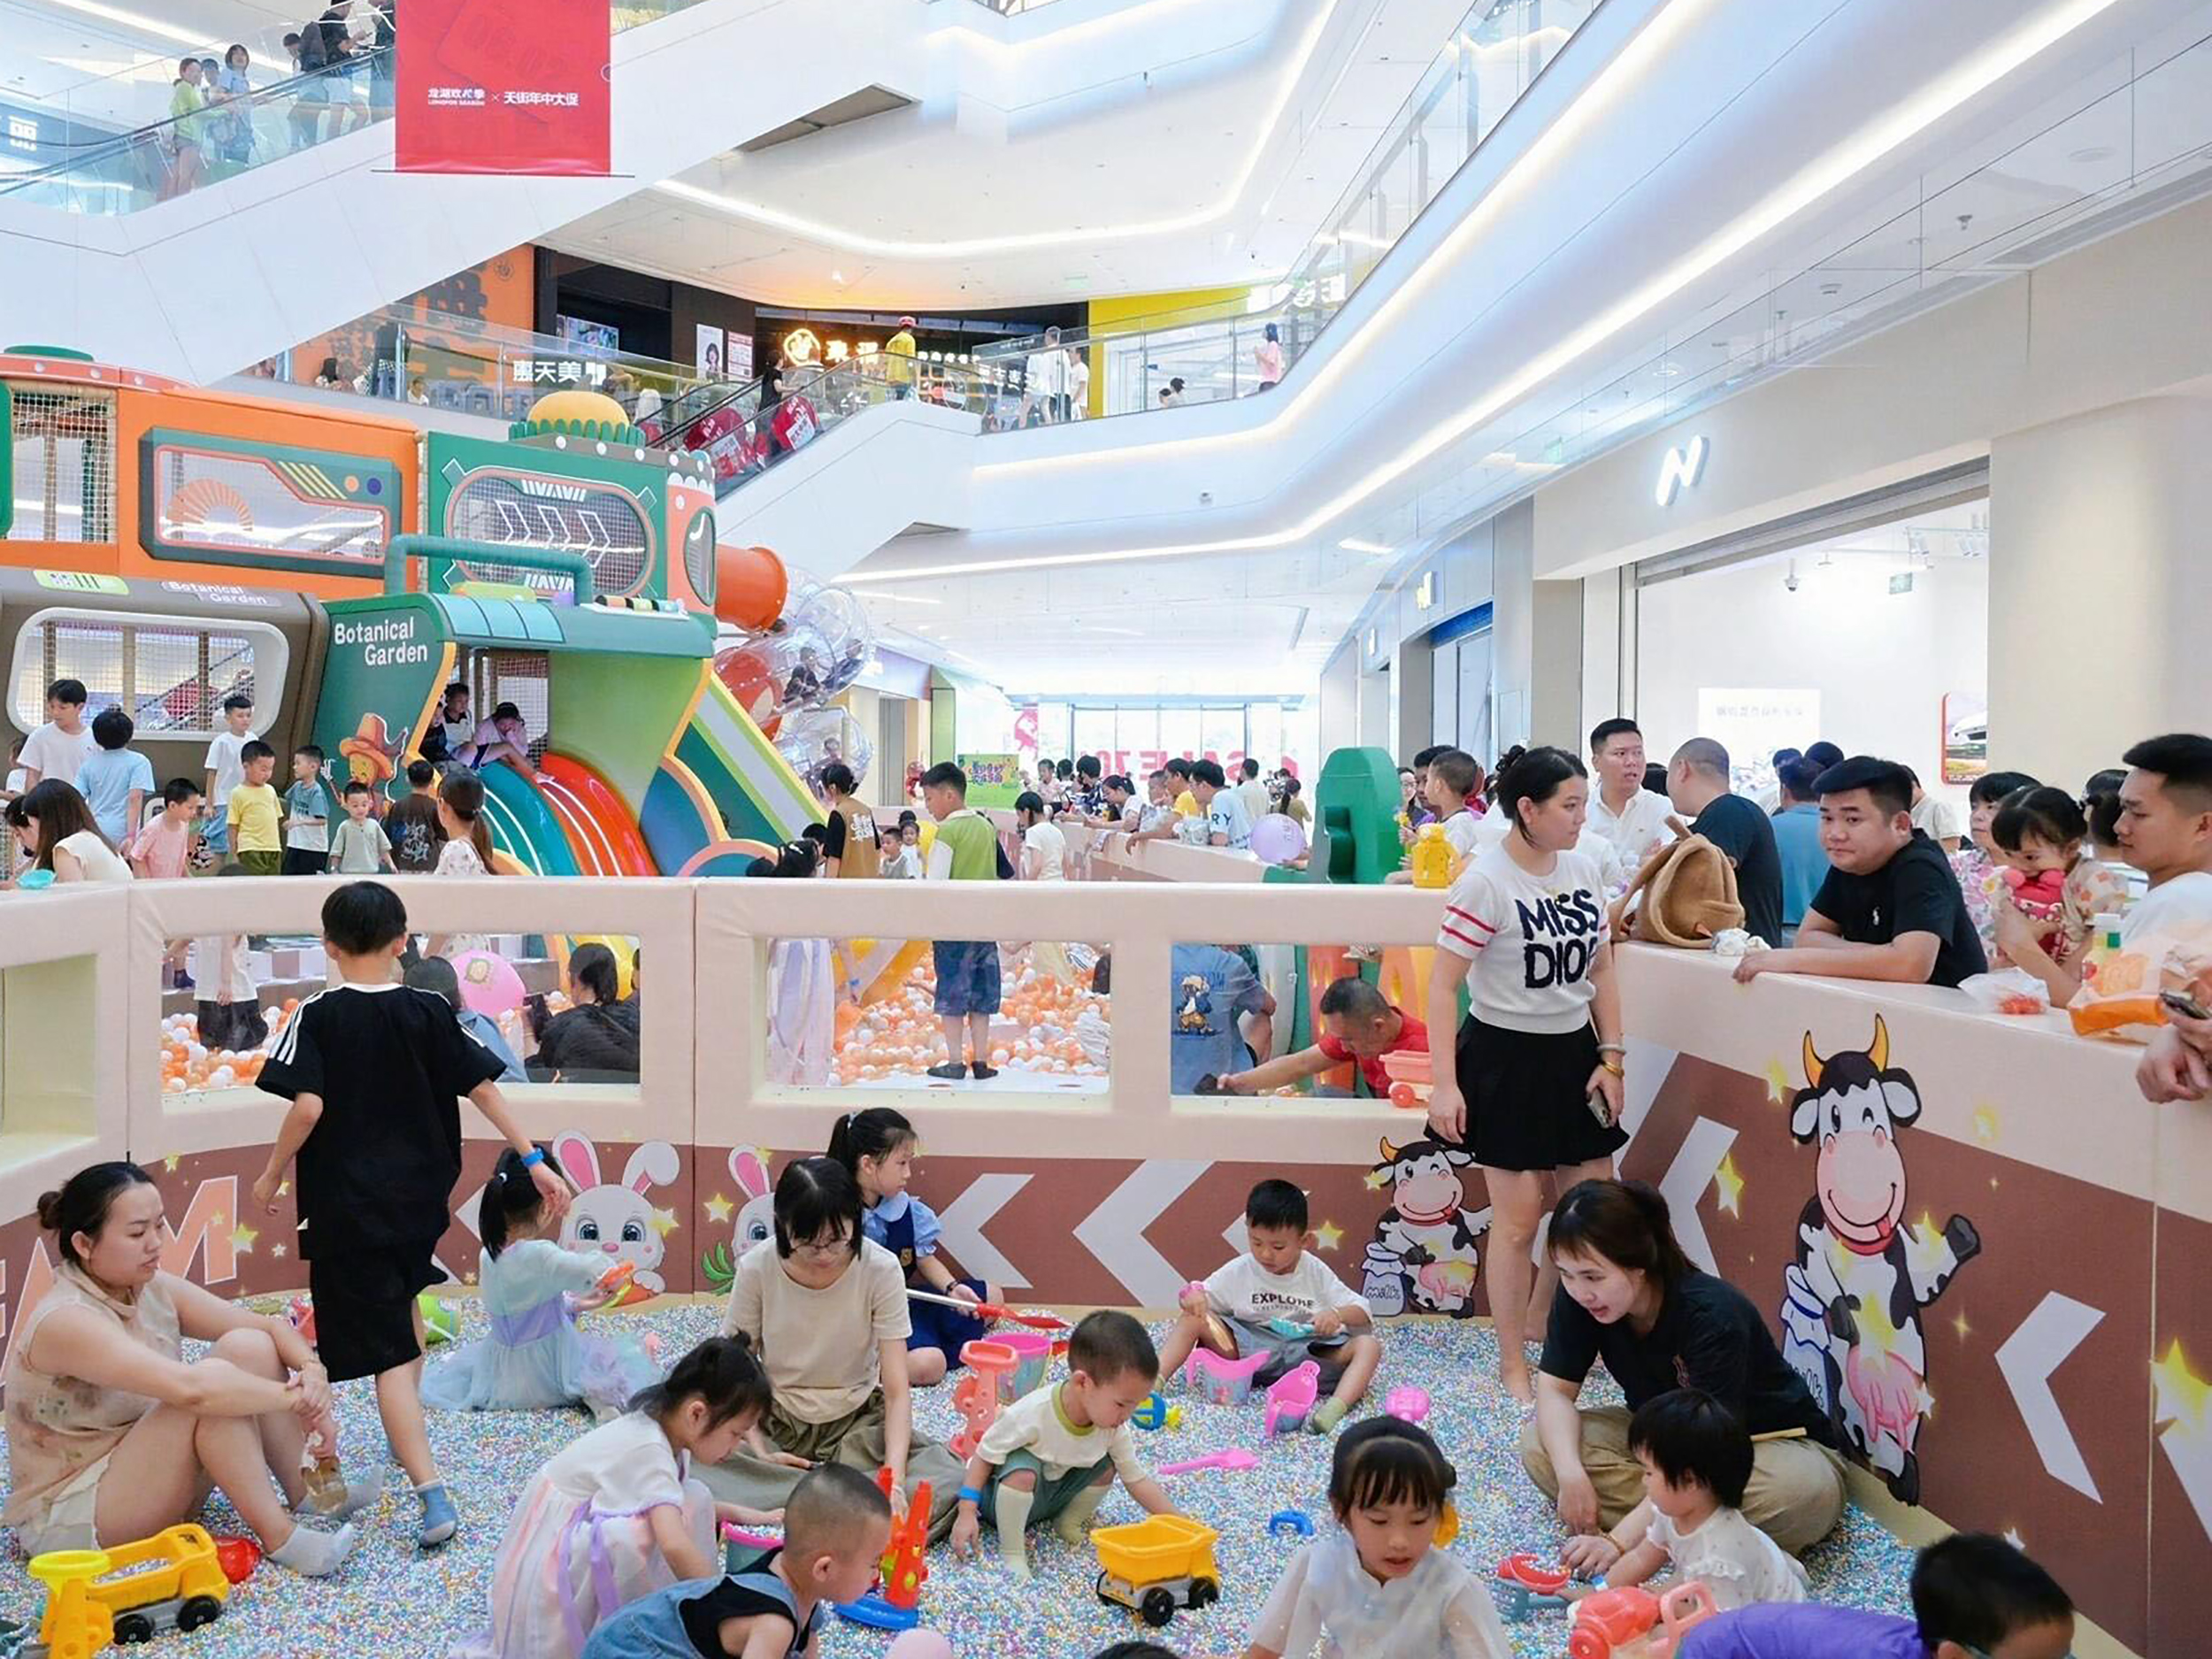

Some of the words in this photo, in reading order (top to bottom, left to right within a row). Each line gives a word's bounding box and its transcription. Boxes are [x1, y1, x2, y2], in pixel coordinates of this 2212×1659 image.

[503, 91, 580, 106] 天街年中大促
[167, 580, 244, 594] Botanical
[209, 593, 268, 604] Garden
[334, 616, 415, 645] Botanical
[365, 641, 428, 666] Garden
[1515, 888, 1600, 941] MISS
[1365, 1284, 1402, 1301] milk
